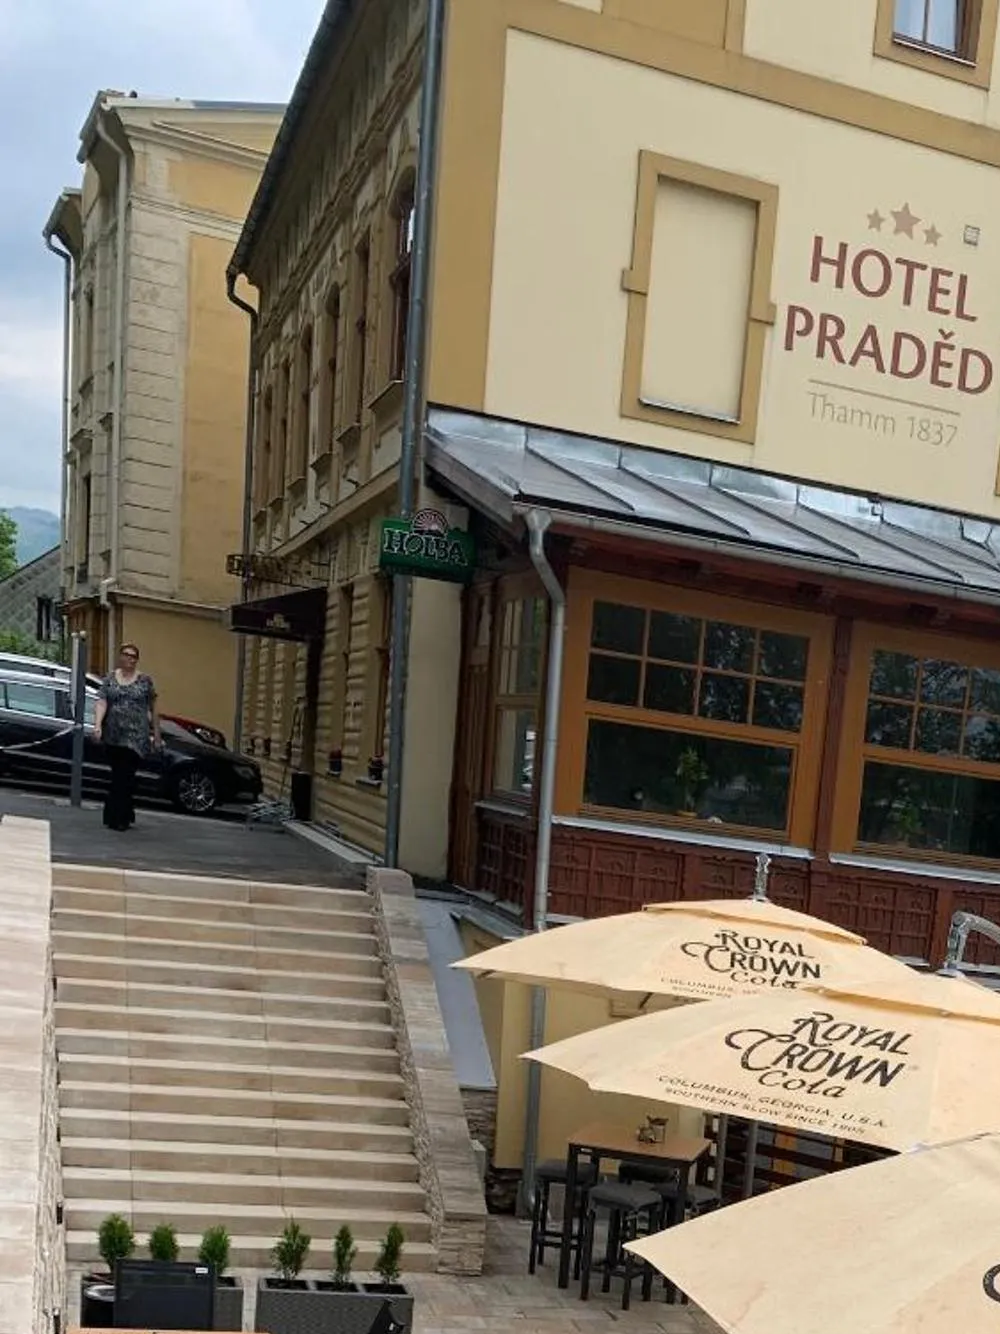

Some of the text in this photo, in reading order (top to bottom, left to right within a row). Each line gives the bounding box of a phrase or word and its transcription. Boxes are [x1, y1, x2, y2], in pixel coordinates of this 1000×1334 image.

[810, 235, 978, 322] HOTEL
[784, 305, 993, 395] PRADĚD
[807, 391, 958, 446] Thamm 1837
[383, 527, 469, 566] HOLBA
[680, 942, 820, 979] CROWN
[714, 929, 815, 958] ROYAL
[730, 971, 799, 989] Cola
[793, 1011, 912, 1055] ROYAL
[725, 1029, 905, 1087] CROWN
[758, 1070, 847, 1099] Cola
